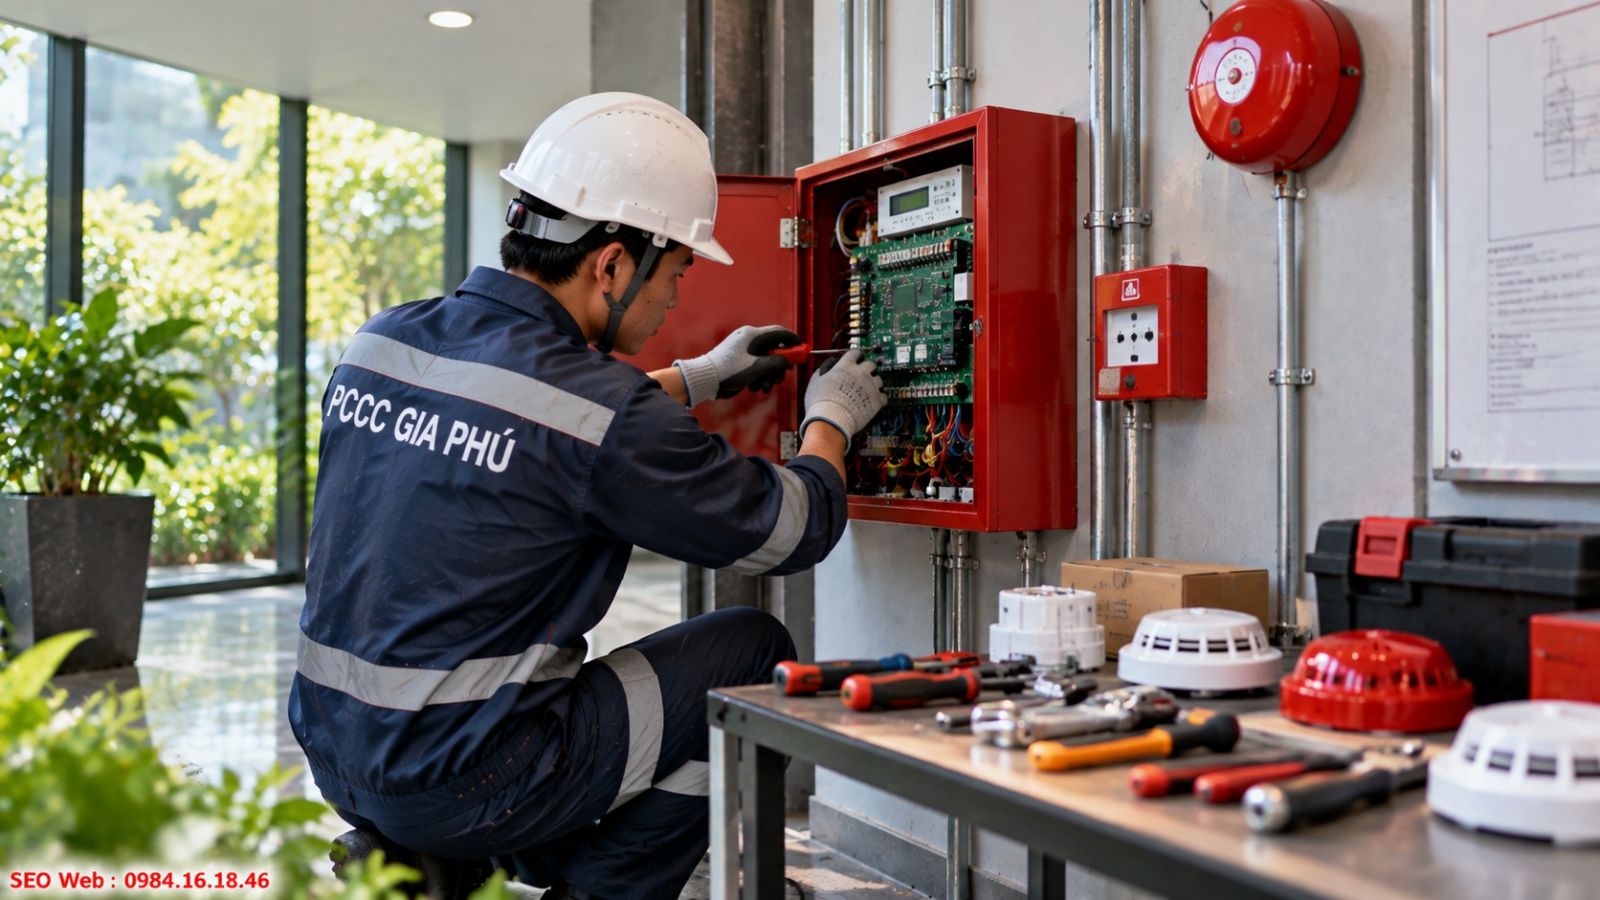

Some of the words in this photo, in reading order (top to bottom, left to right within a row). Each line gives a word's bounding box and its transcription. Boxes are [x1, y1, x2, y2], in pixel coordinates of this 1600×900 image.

[326, 384, 392, 433] PCCC
[394, 406, 440, 451] GIA
[442, 420, 516, 473] PHÚ
